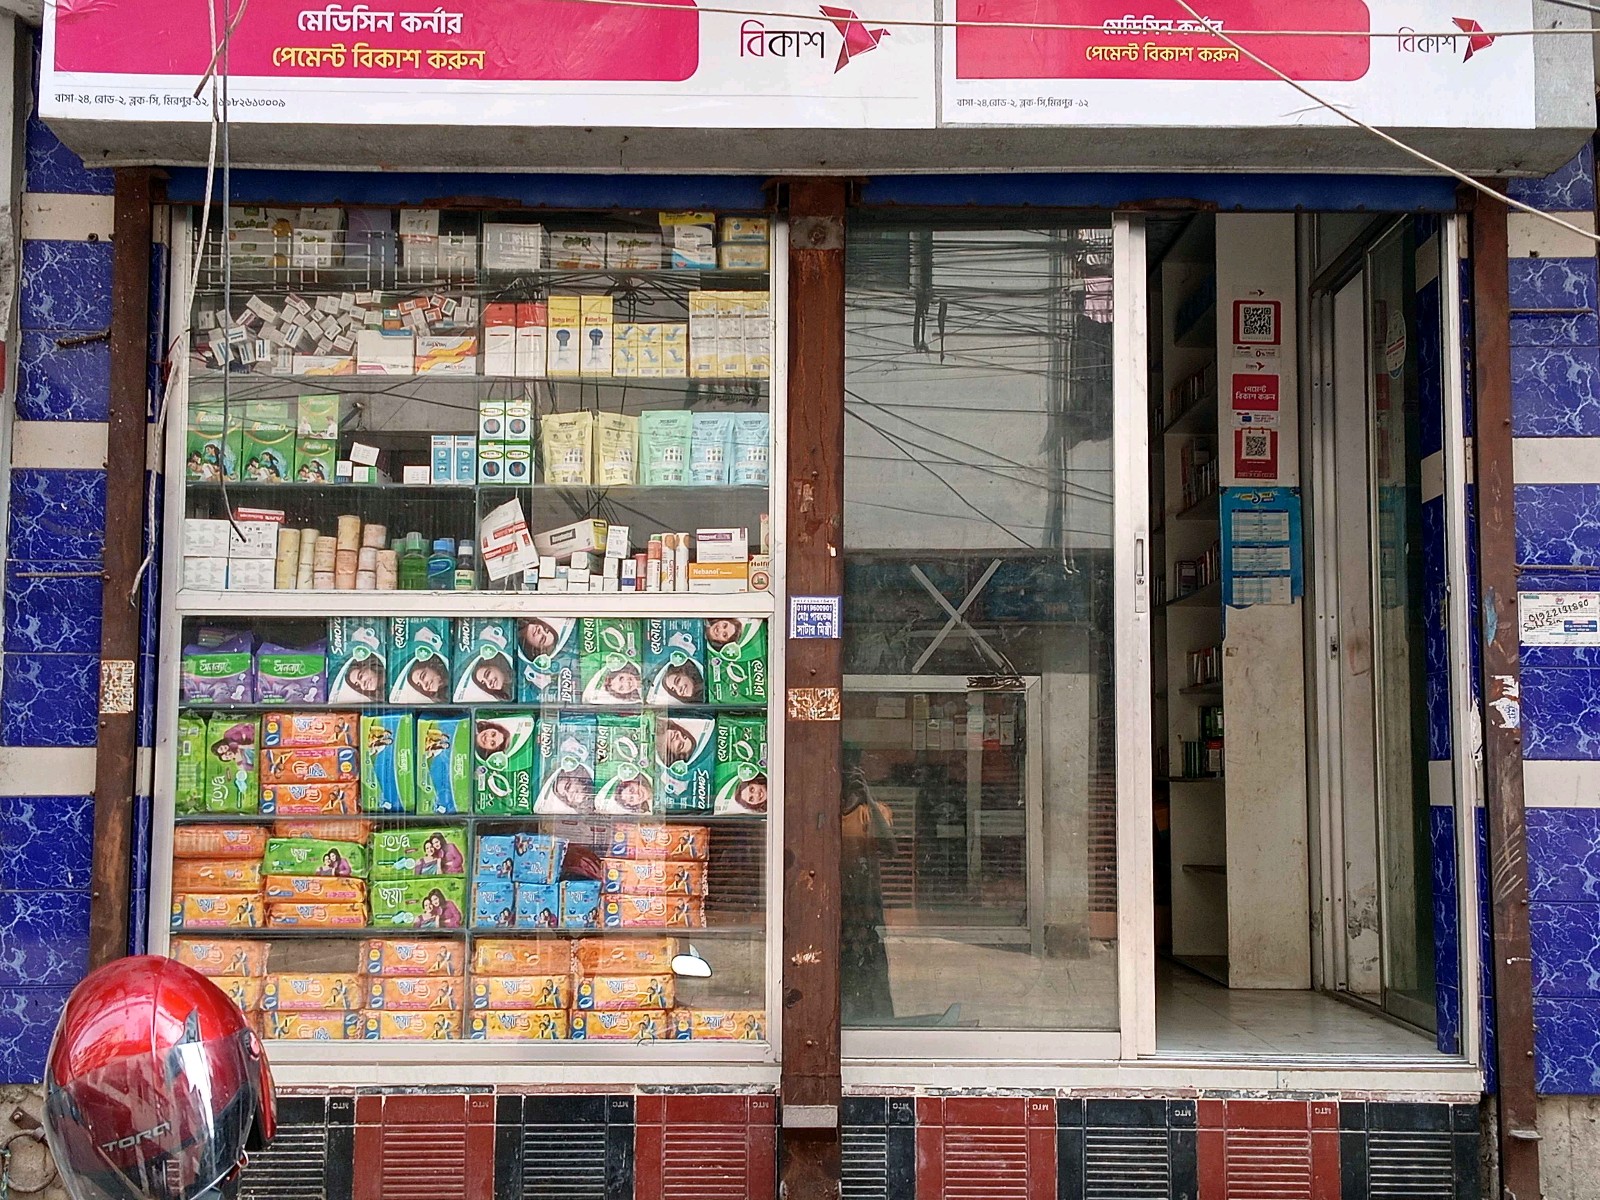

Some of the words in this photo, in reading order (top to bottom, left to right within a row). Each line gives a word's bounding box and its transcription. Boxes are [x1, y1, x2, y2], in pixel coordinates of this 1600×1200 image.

[297, 4, 393, 34] মেডিসিন
[400, 6, 463, 35] কর্নার
[1102, 14, 1172, 36] মেডিসিন
[1178, 16, 1223, 36] কর্নার
[740, 20, 825, 58] বিকাশ
[1398, 26, 1457, 53] বিকাশ
[272, 43, 347, 68] পেমেন্ট
[352, 42, 420, 70] বিকাশ
[427, 48, 485, 70] করুন
[1085, 44, 1140, 62] পেমেন্ট
[1143, 43, 1194, 63] বিকাশ
[1198, 47, 1240, 63] করুন
[394, 617, 407, 649] সেনোর
[750, 660, 765, 698] সেনোরা
[718, 726, 729, 762] সেনোরা
[212, 775, 229, 807] Joya
[518, 771, 530, 809] সেনোরা
[379, 834, 411, 852] Joya
[378, 885, 409, 909] জয়া
[332, 1102, 349, 1110] MTC
[472, 1101, 490, 1109] MTC
[612, 1100, 629, 1108] MTC
[752, 1101, 769, 1109] MTC
[1032, 1103, 1049, 1111] MTC
[1175, 1109, 1191, 1117] MTC
[1315, 1107, 1331, 1115] MTC
